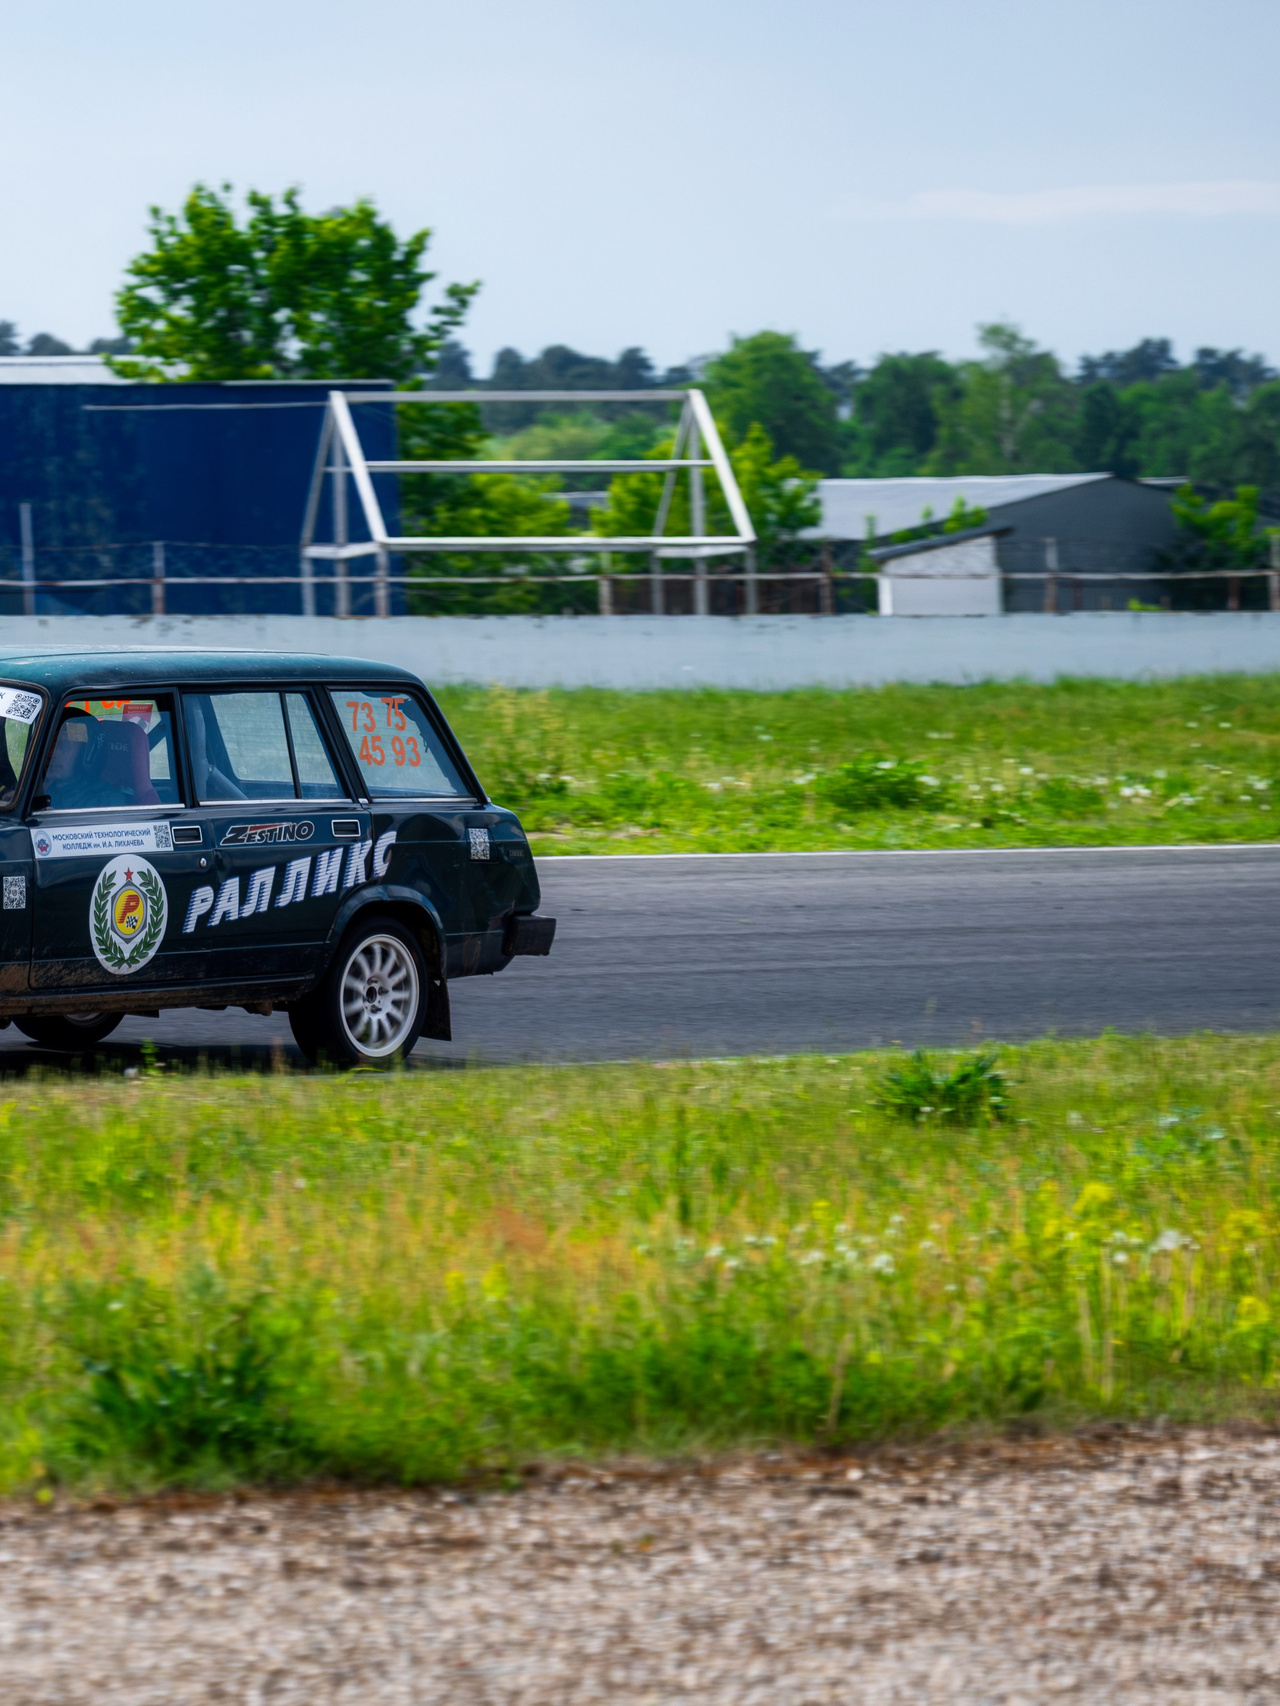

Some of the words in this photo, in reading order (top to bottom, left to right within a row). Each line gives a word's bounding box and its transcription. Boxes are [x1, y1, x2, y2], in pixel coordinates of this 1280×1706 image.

[346, 701, 376, 732] 73
[381, 697, 407, 731] 75
[359, 735, 385, 766] 45
[391, 735, 421, 767] 93
[52, 830, 93, 841] МОСКОВСКИЙ
[94, 828, 152, 839] ТЕХНОЛОГИЧЕСКИЙ
[62, 840, 92, 850] КОЛЛЕДЖ
[114, 838, 145, 848] ЛИХАЧЕВА
[220, 820, 315, 846] ZESTINO
[182, 830, 398, 934] РАЛЛИКС
